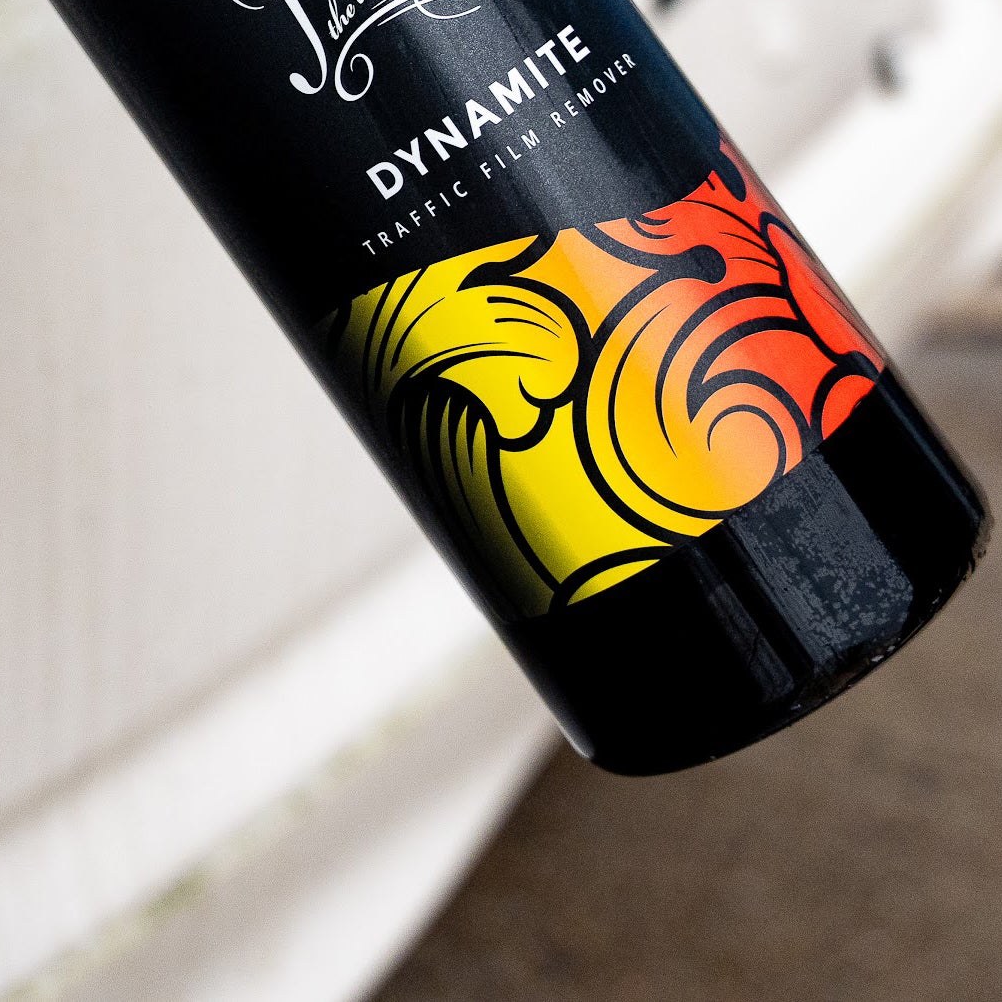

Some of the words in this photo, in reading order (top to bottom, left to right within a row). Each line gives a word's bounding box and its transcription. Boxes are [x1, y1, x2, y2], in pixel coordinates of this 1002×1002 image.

[362, 180, 469, 256] TRAFFIC
[479, 129, 541, 180] FILM
[549, 52, 637, 128] REMOVER
[365, 24, 591, 200] DYNAMITE
